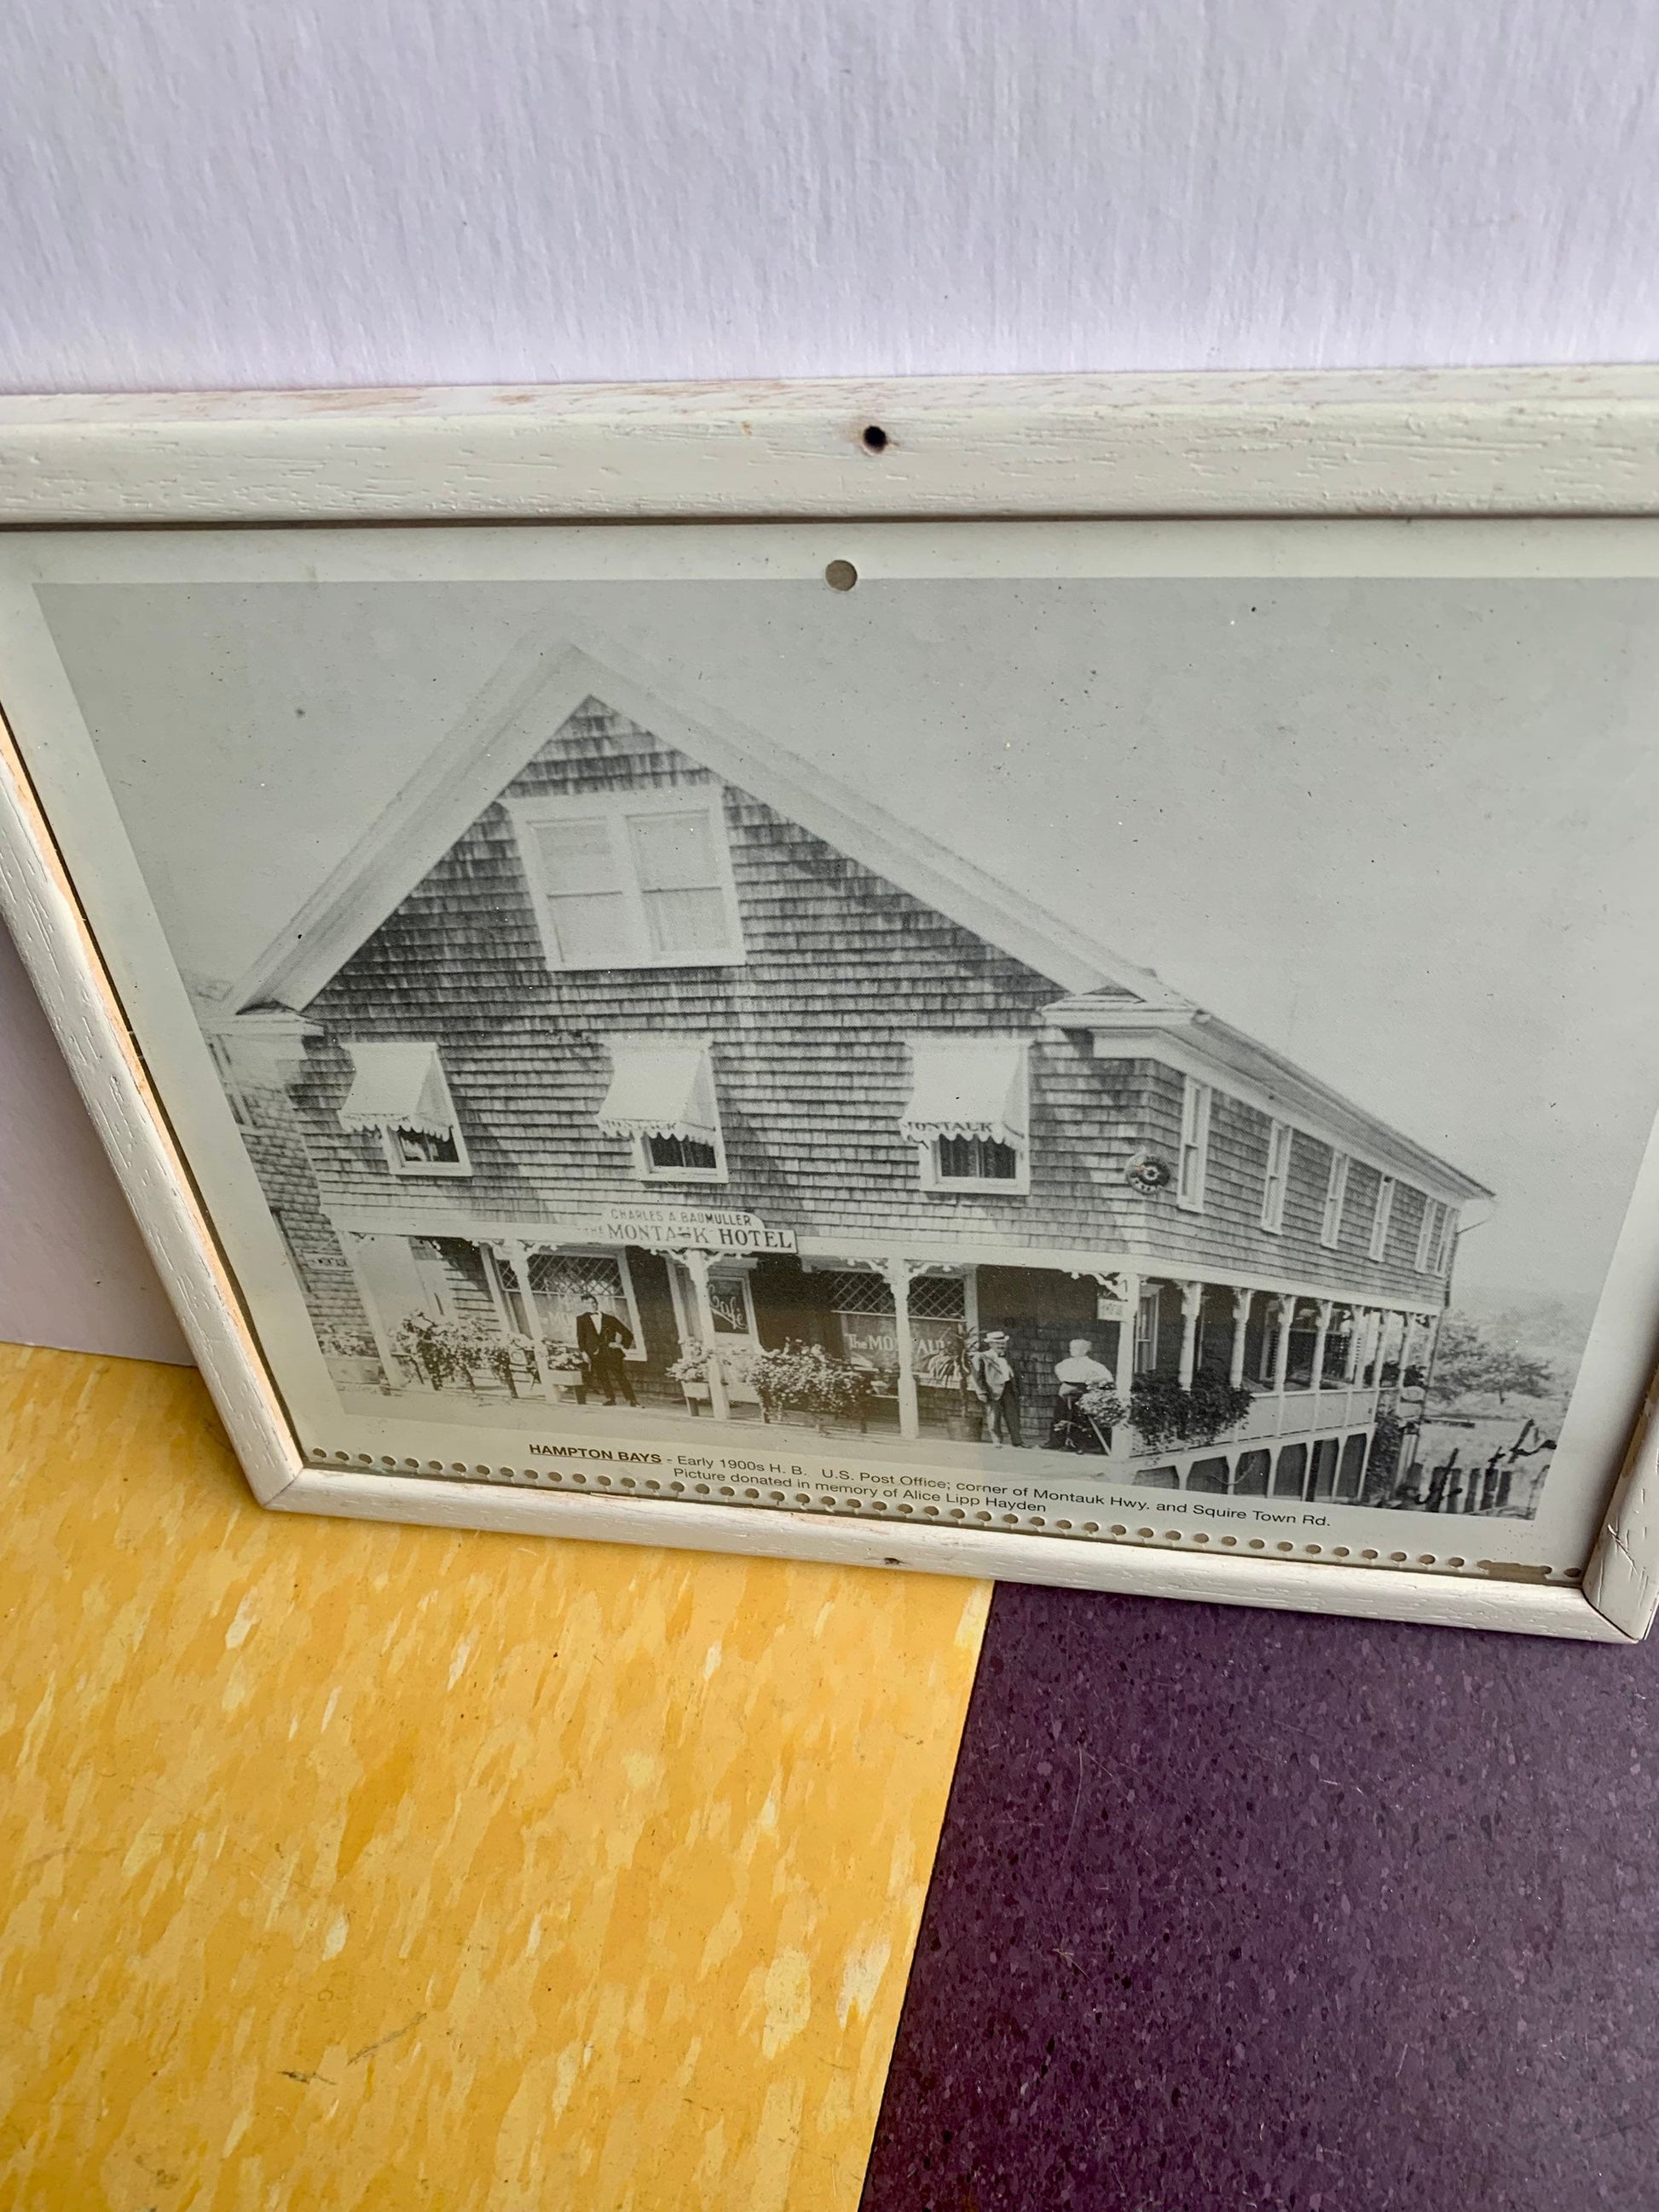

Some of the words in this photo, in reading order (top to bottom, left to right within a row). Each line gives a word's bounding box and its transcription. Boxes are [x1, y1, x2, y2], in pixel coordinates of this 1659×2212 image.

[610, 1209, 663, 1222] CHARLES
[681, 1211, 752, 1226] BAUMULLER
[719, 1227, 793, 1249] HOTEL
[845, 1333, 867, 1350] The
[529, 1443, 613, 1461] HAMPTON
[618, 1452, 663, 1464] BAYS
[677, 1455, 714, 1469] Early
[720, 1458, 765, 1472] 1900s
[769, 1463, 786, 1474] H.
[791, 1465, 807, 1476] B.
[822, 1469, 854, 1481] U.S.
[859, 1472, 895, 1485] Post
[899, 1476, 951, 1491] Office;
[956, 1482, 1008, 1494] corner
[1012, 1486, 1029, 1497] of
[1033, 1488, 1105, 1505] Montauk
[1110, 1497, 1150, 1511] Hwy.
[1156, 1502, 1188, 1513] and
[1193, 1505, 1246, 1519] Squire
[1252, 1510, 1297, 1523] Town
[1302, 1515, 1331, 1527] Rd.
[673, 1468, 725, 1481] Picture
[730, 1473, 792, 1487] donated
[797, 1479, 811, 1489] in
[815, 1483, 878, 1499] memory
[882, 1486, 899, 1498] of
[902, 1488, 941, 1502] Alice
[945, 1493, 980, 1507] Lipp
[986, 1497, 1046, 1512] Hayden
